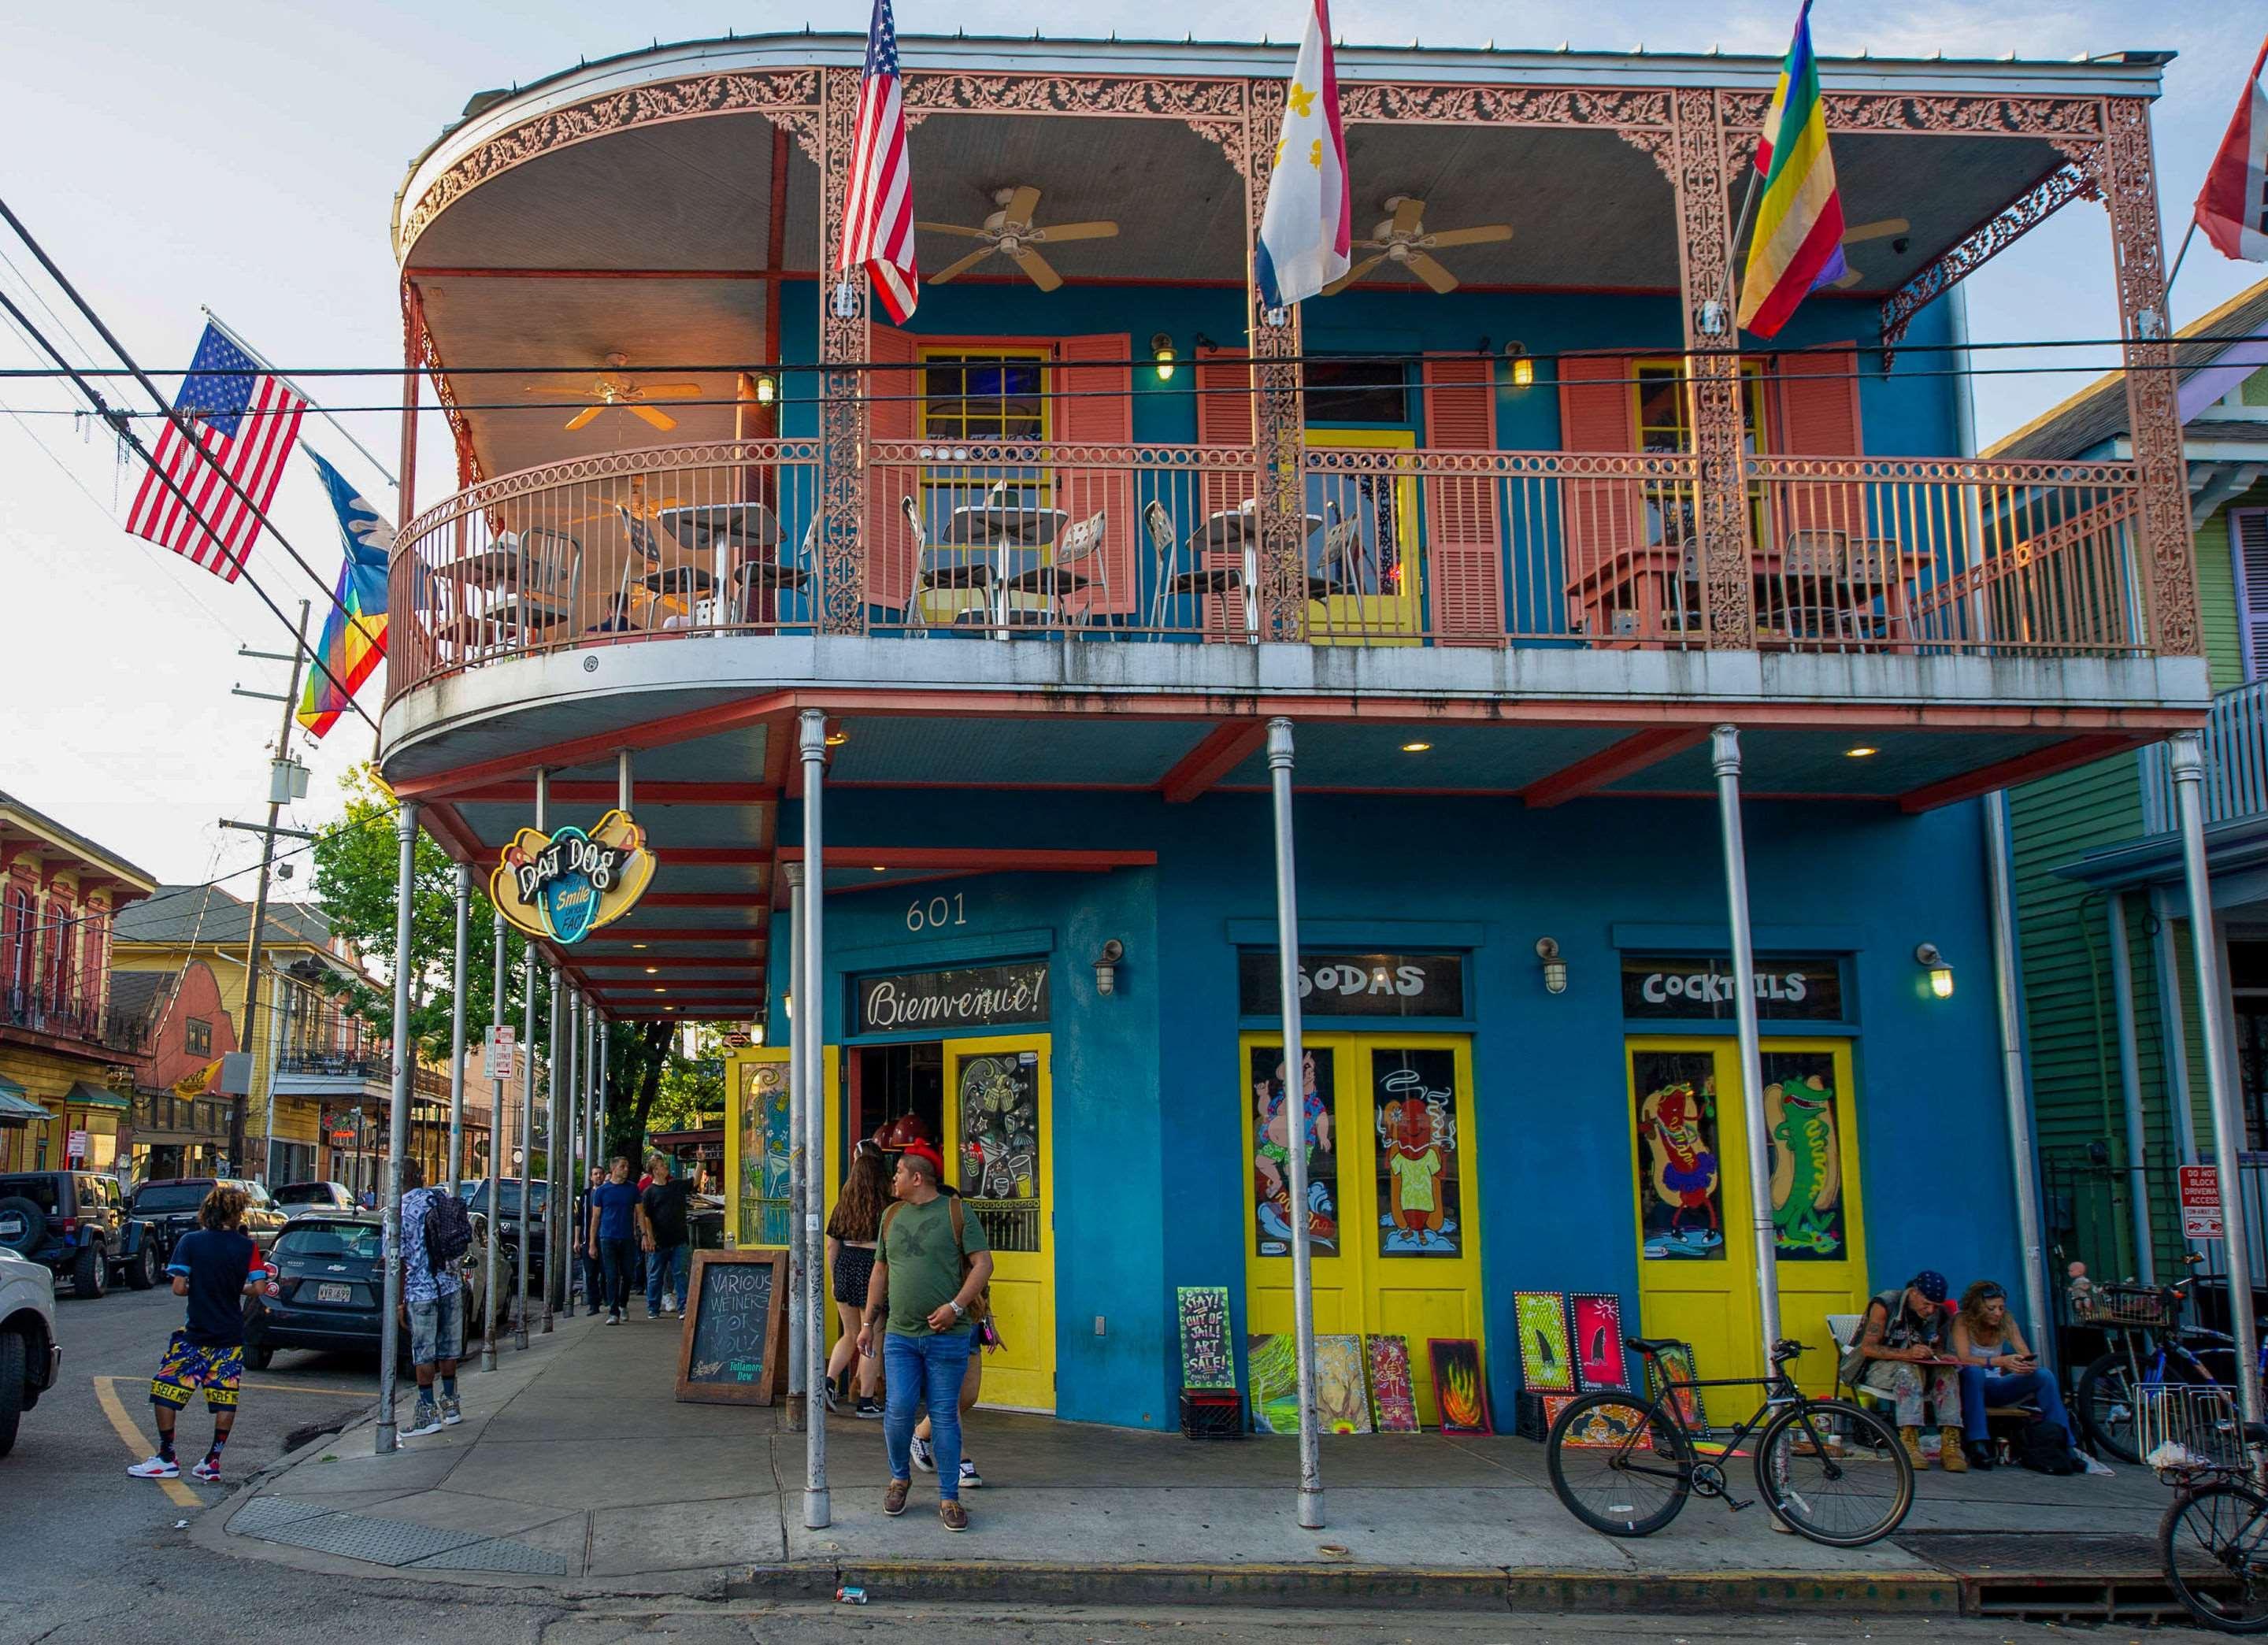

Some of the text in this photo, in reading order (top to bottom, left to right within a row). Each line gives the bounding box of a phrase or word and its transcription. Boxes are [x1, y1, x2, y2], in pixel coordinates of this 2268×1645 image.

[520, 845, 561, 902] DAT
[556, 886, 591, 910] Smile
[906, 892, 966, 932] 601
[1643, 973, 1807, 1003] COCKTILS
[867, 969, 1047, 1025] Bienvenue!
[710, 1273, 773, 1294] VARIOUS
[336, 1289, 350, 1299] 699
[1185, 1295, 1219, 1309] STAY!
[1185, 1311, 1223, 1327] OUT OF
[1195, 1340, 1219, 1353] ART
[730, 1362, 763, 1372] Tullamore
[1189, 1354, 1225, 1370] SALE!
[737, 1371, 754, 1381] Dew
[157, 1383, 176, 1399] SELF
[212, 1391, 230, 1402] SELF
